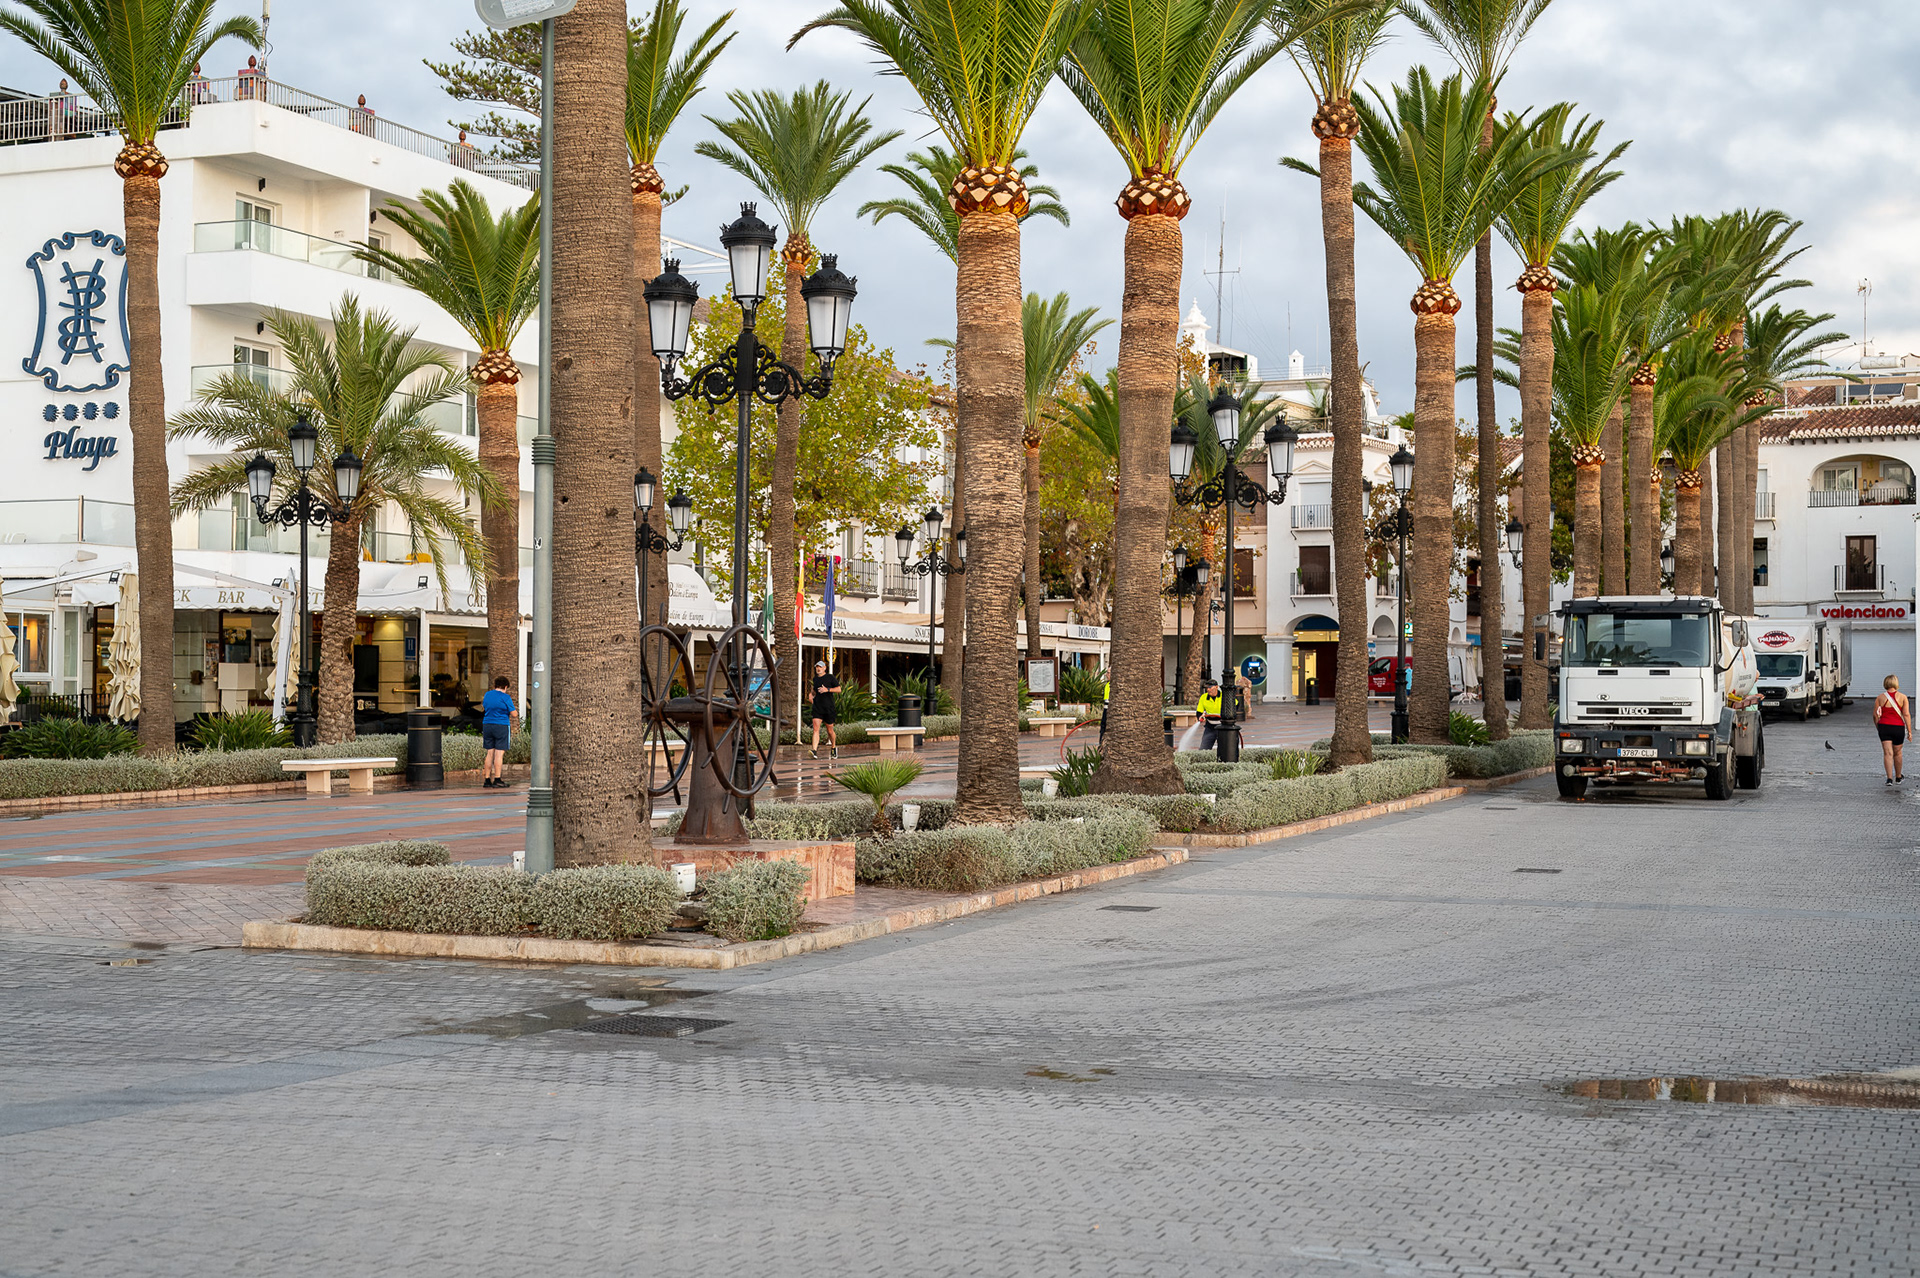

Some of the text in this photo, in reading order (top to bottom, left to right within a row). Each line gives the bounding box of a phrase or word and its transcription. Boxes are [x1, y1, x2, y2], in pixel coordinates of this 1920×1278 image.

[43, 425, 118, 471] Playa
[217, 591, 245, 604] BAR
[1821, 604, 1905, 618] valenciano
[1619, 707, 1650, 715] IVECO
